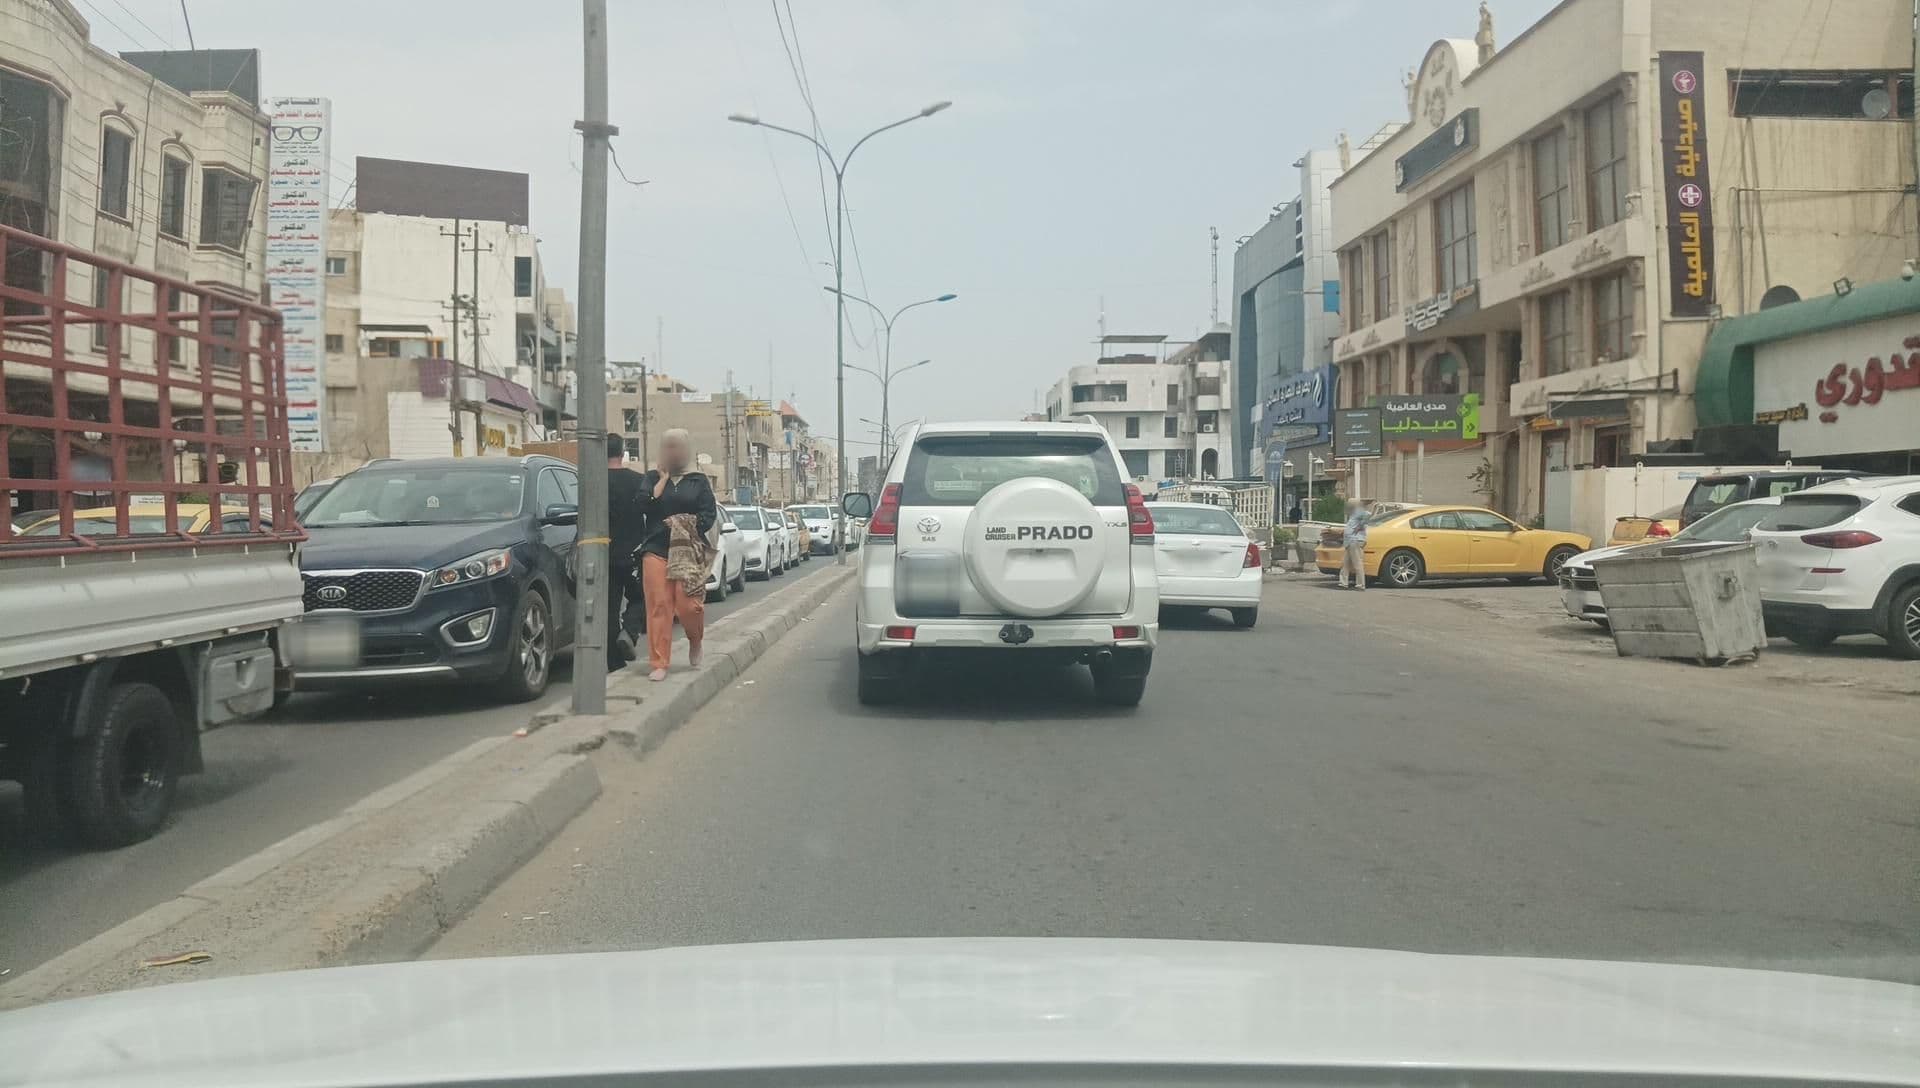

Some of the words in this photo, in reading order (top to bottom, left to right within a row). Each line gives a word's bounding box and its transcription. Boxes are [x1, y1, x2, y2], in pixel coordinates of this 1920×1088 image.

[1675, 98, 1700, 177] صيدلية
[282, 159, 308, 168] الدكتور
[281, 191, 307, 199] الدكتور
[280, 223, 305, 232] الدكتور
[1679, 212, 1707, 296] العالمية
[1386, 401, 1422, 412] العالمية
[1423, 402, 1447, 412] صدى
[985, 533, 1016, 541] CRUISER
[1017, 525, 1093, 540] PRADO
[321, 589, 342, 599] KIA
